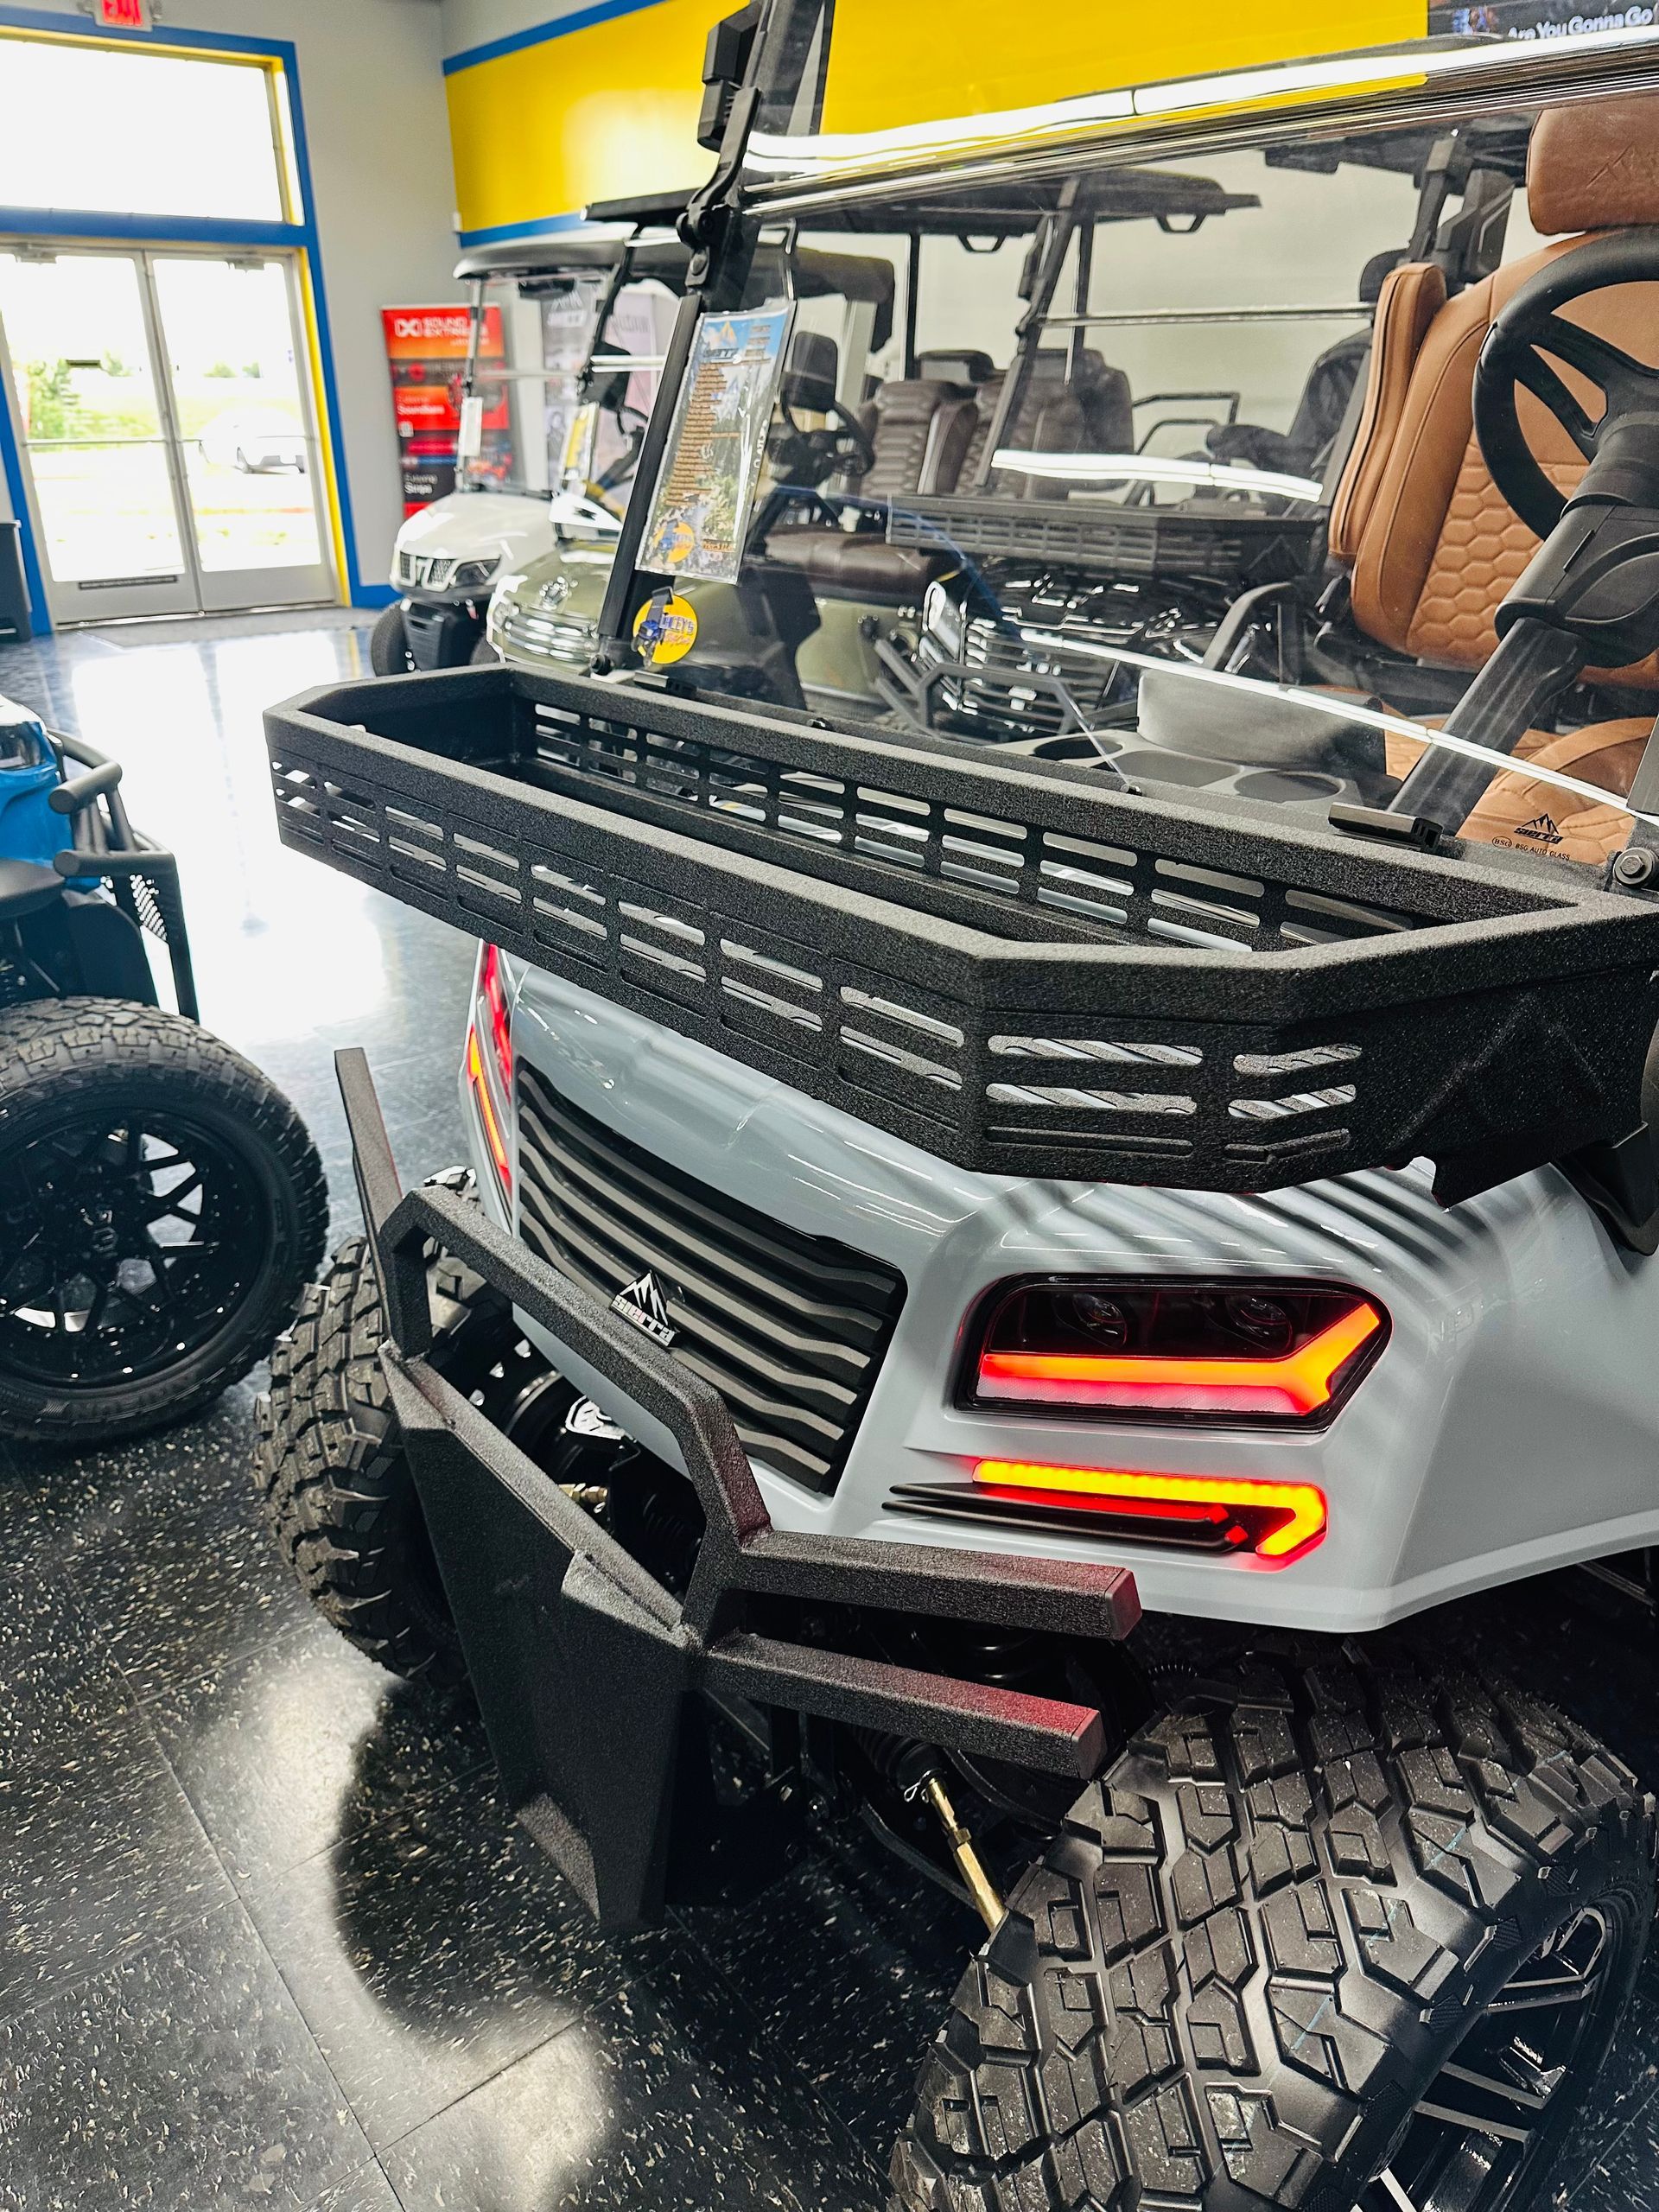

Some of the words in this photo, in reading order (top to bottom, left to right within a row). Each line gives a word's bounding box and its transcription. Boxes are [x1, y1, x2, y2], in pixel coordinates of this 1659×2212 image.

[1536, 21, 1567, 39] You
[1568, 14, 1624, 35] Gonna
[1624, 6, 1654, 26] Go
[1493, 838, 1511, 848] BSG
[1529, 847, 1548, 855] AUTO
[1549, 851, 1571, 861] GLASS
[610, 1294, 676, 1344] sierra
